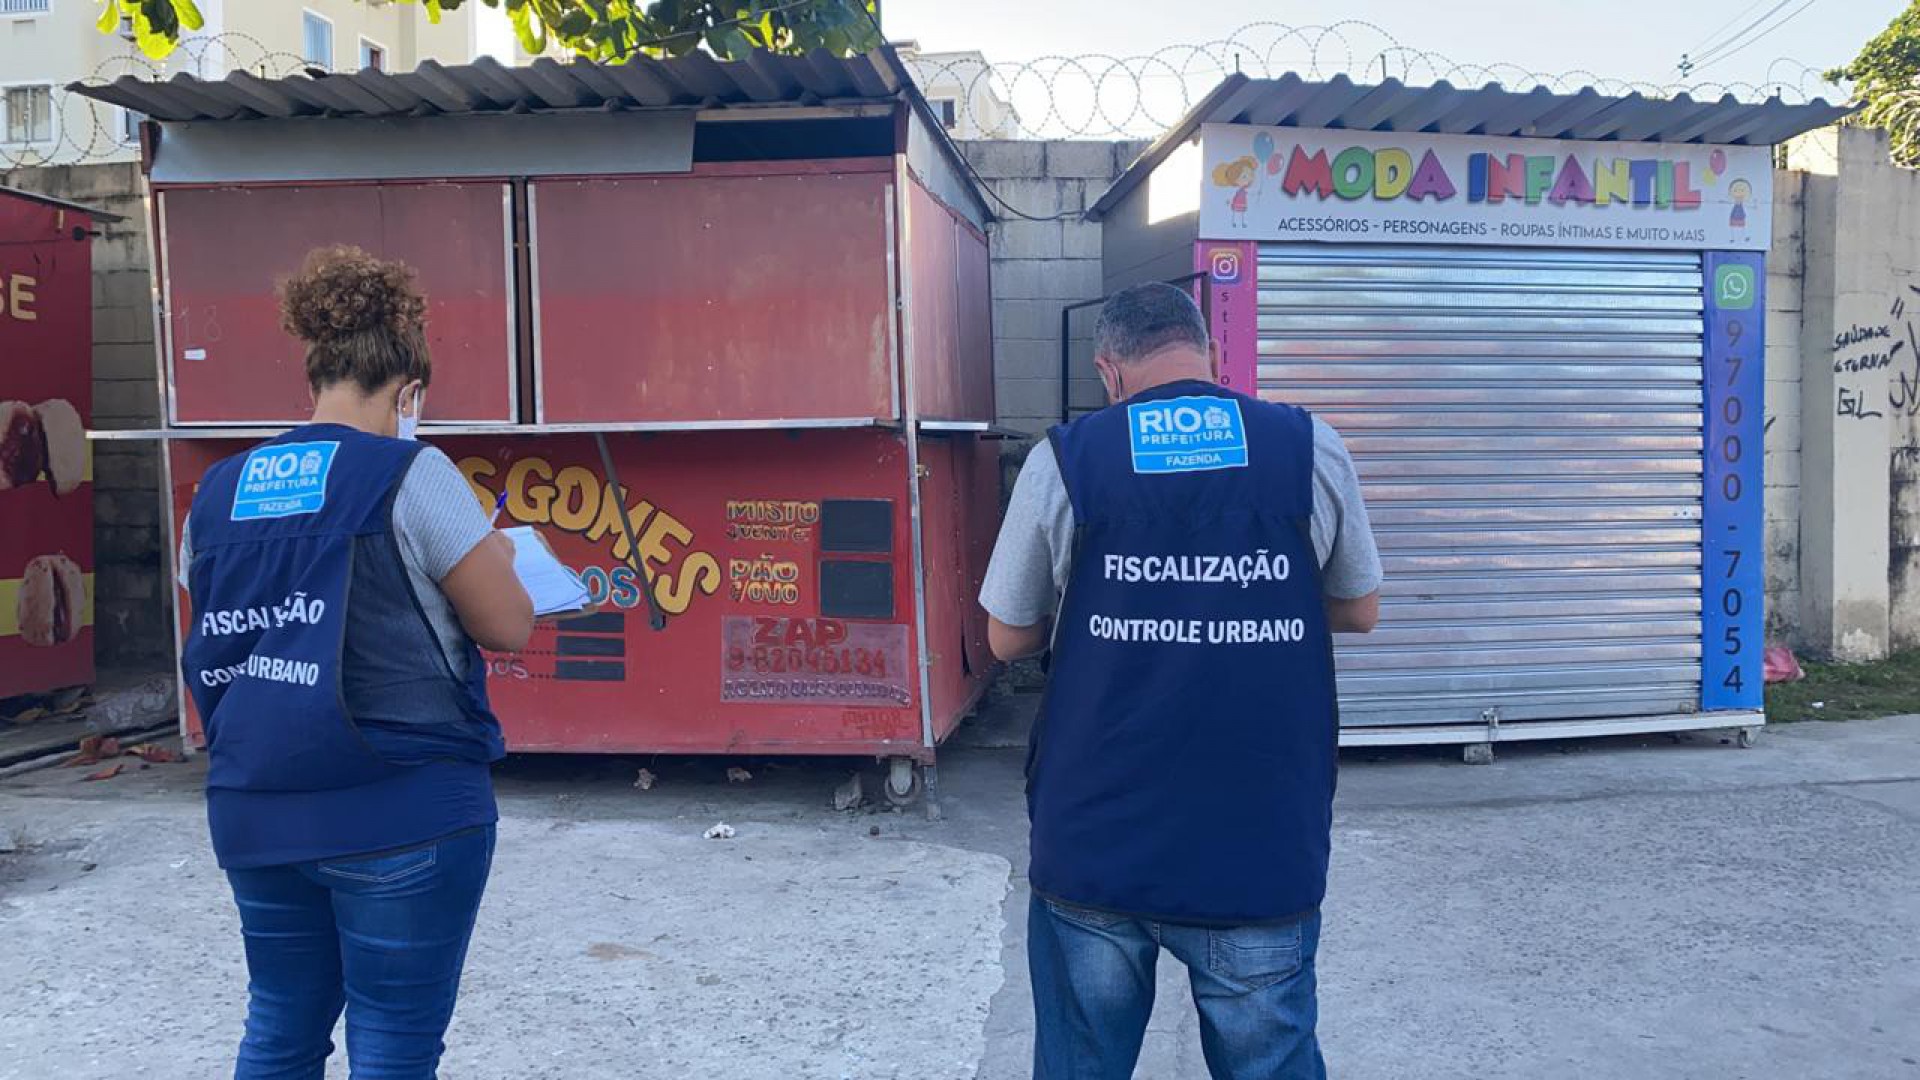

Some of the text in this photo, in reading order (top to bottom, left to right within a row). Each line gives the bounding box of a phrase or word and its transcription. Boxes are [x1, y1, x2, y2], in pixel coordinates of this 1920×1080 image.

[1282, 143, 1702, 212] MODA INFANTIL
[1278, 215, 1369, 232] ACESSÓRIOS
[1383, 220, 1487, 235] PERSONAGENS
[1500, 223, 1555, 237] ROUPAS
[1559, 221, 1611, 239] ÍNTIMAS
[1616, 226, 1623, 238] E
[1626, 227, 1670, 241] MUITO
[1673, 228, 1705, 242] MAIS
[0, 274, 37, 319] E
[1139, 407, 1200, 433] RIO
[1141, 430, 1234, 445] PREFEITURA
[247, 452, 298, 481] RIO
[1166, 452, 1222, 466] FAZENDA
[244, 477, 318, 493] PREFEITURA
[726, 500, 819, 523] MISTO
[1722, 319, 1744, 694] 97000-7054
[729, 553, 798, 580] PÃO
[1104, 549, 1289, 588] FISCALIZAÇÃO
[562, 566, 640, 608] OS
[754, 617, 847, 646] ZAP
[1089, 614, 1304, 643] CONTROLE URBANO
[248, 654, 319, 687] URBANO
